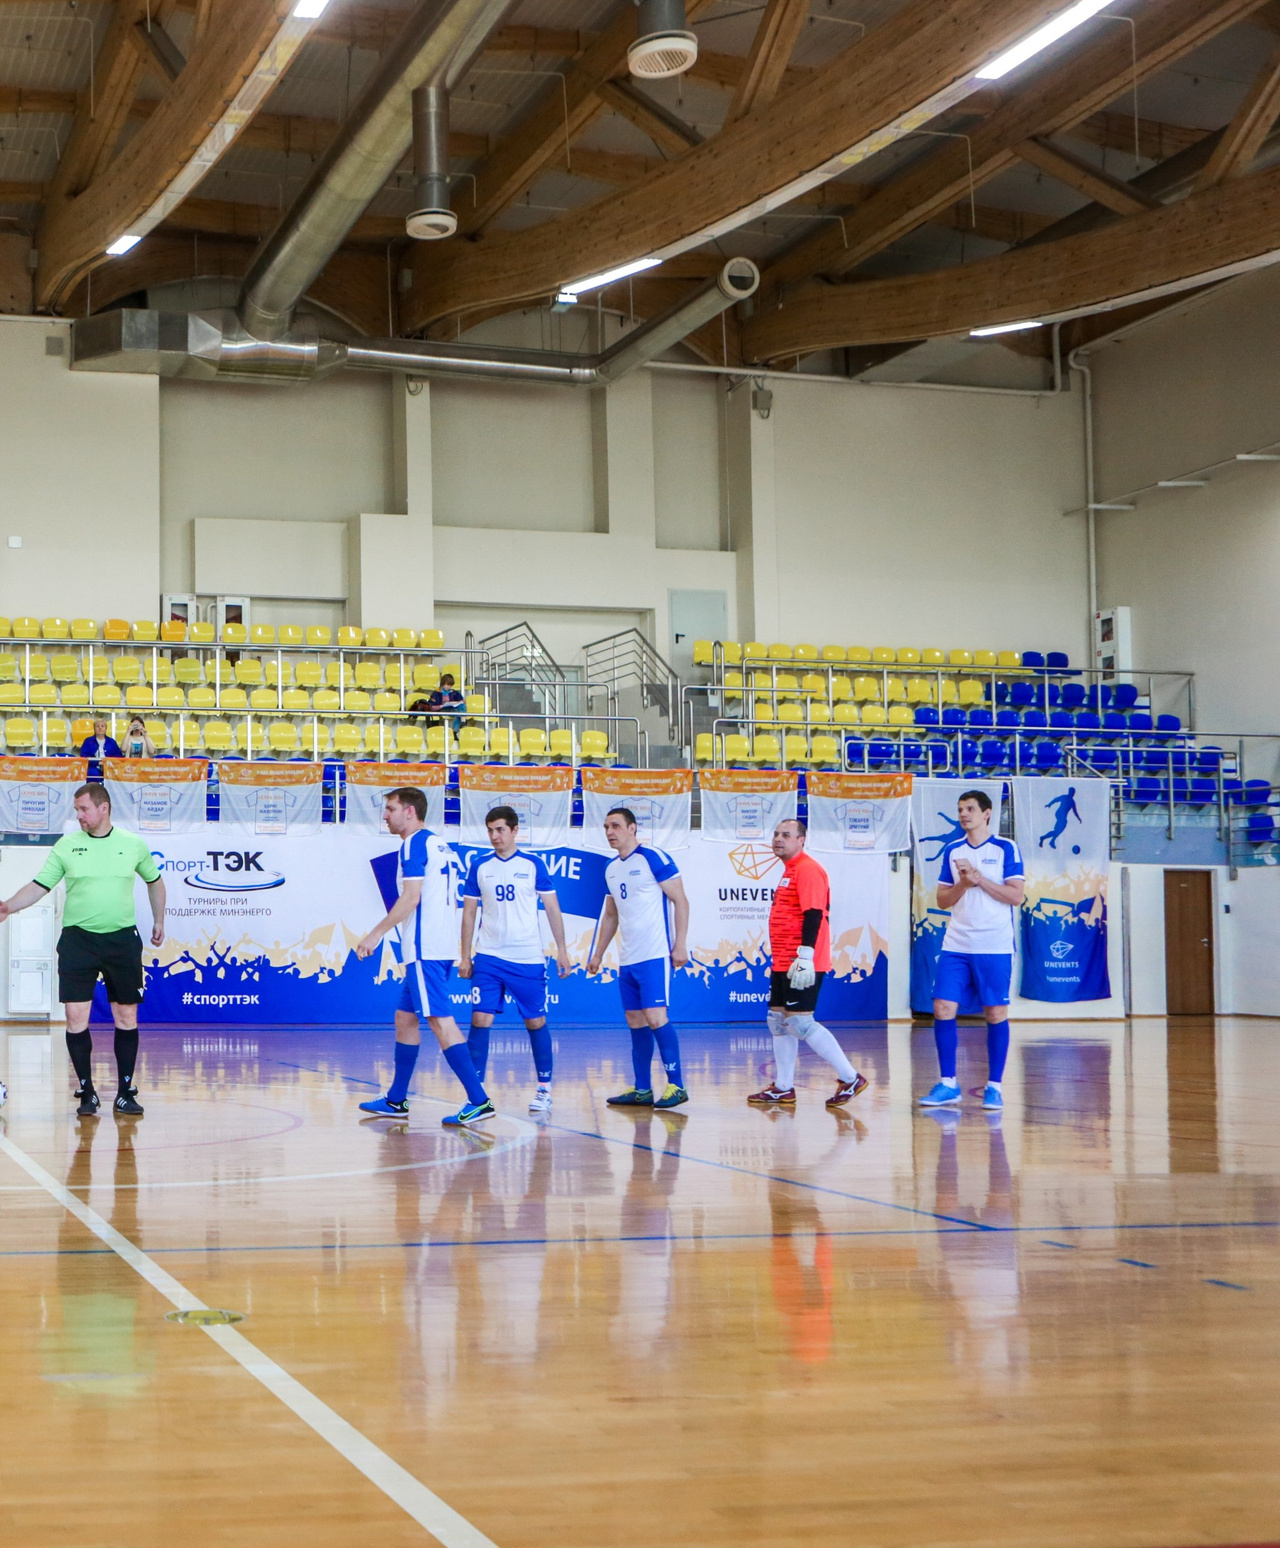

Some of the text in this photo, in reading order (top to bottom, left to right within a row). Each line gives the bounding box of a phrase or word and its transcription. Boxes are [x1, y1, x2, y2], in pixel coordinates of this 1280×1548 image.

[496, 884, 515, 902] 98
[620, 883, 627, 899] 8
[188, 898, 247, 906] ТУРНИРЫ ПРИ
[165, 908, 271, 916] ПОДДЕРЖКЕ МИНЭНЕРГО
[182, 992, 260, 1007] #спорттэк
[729, 991, 771, 1002] #uneve
